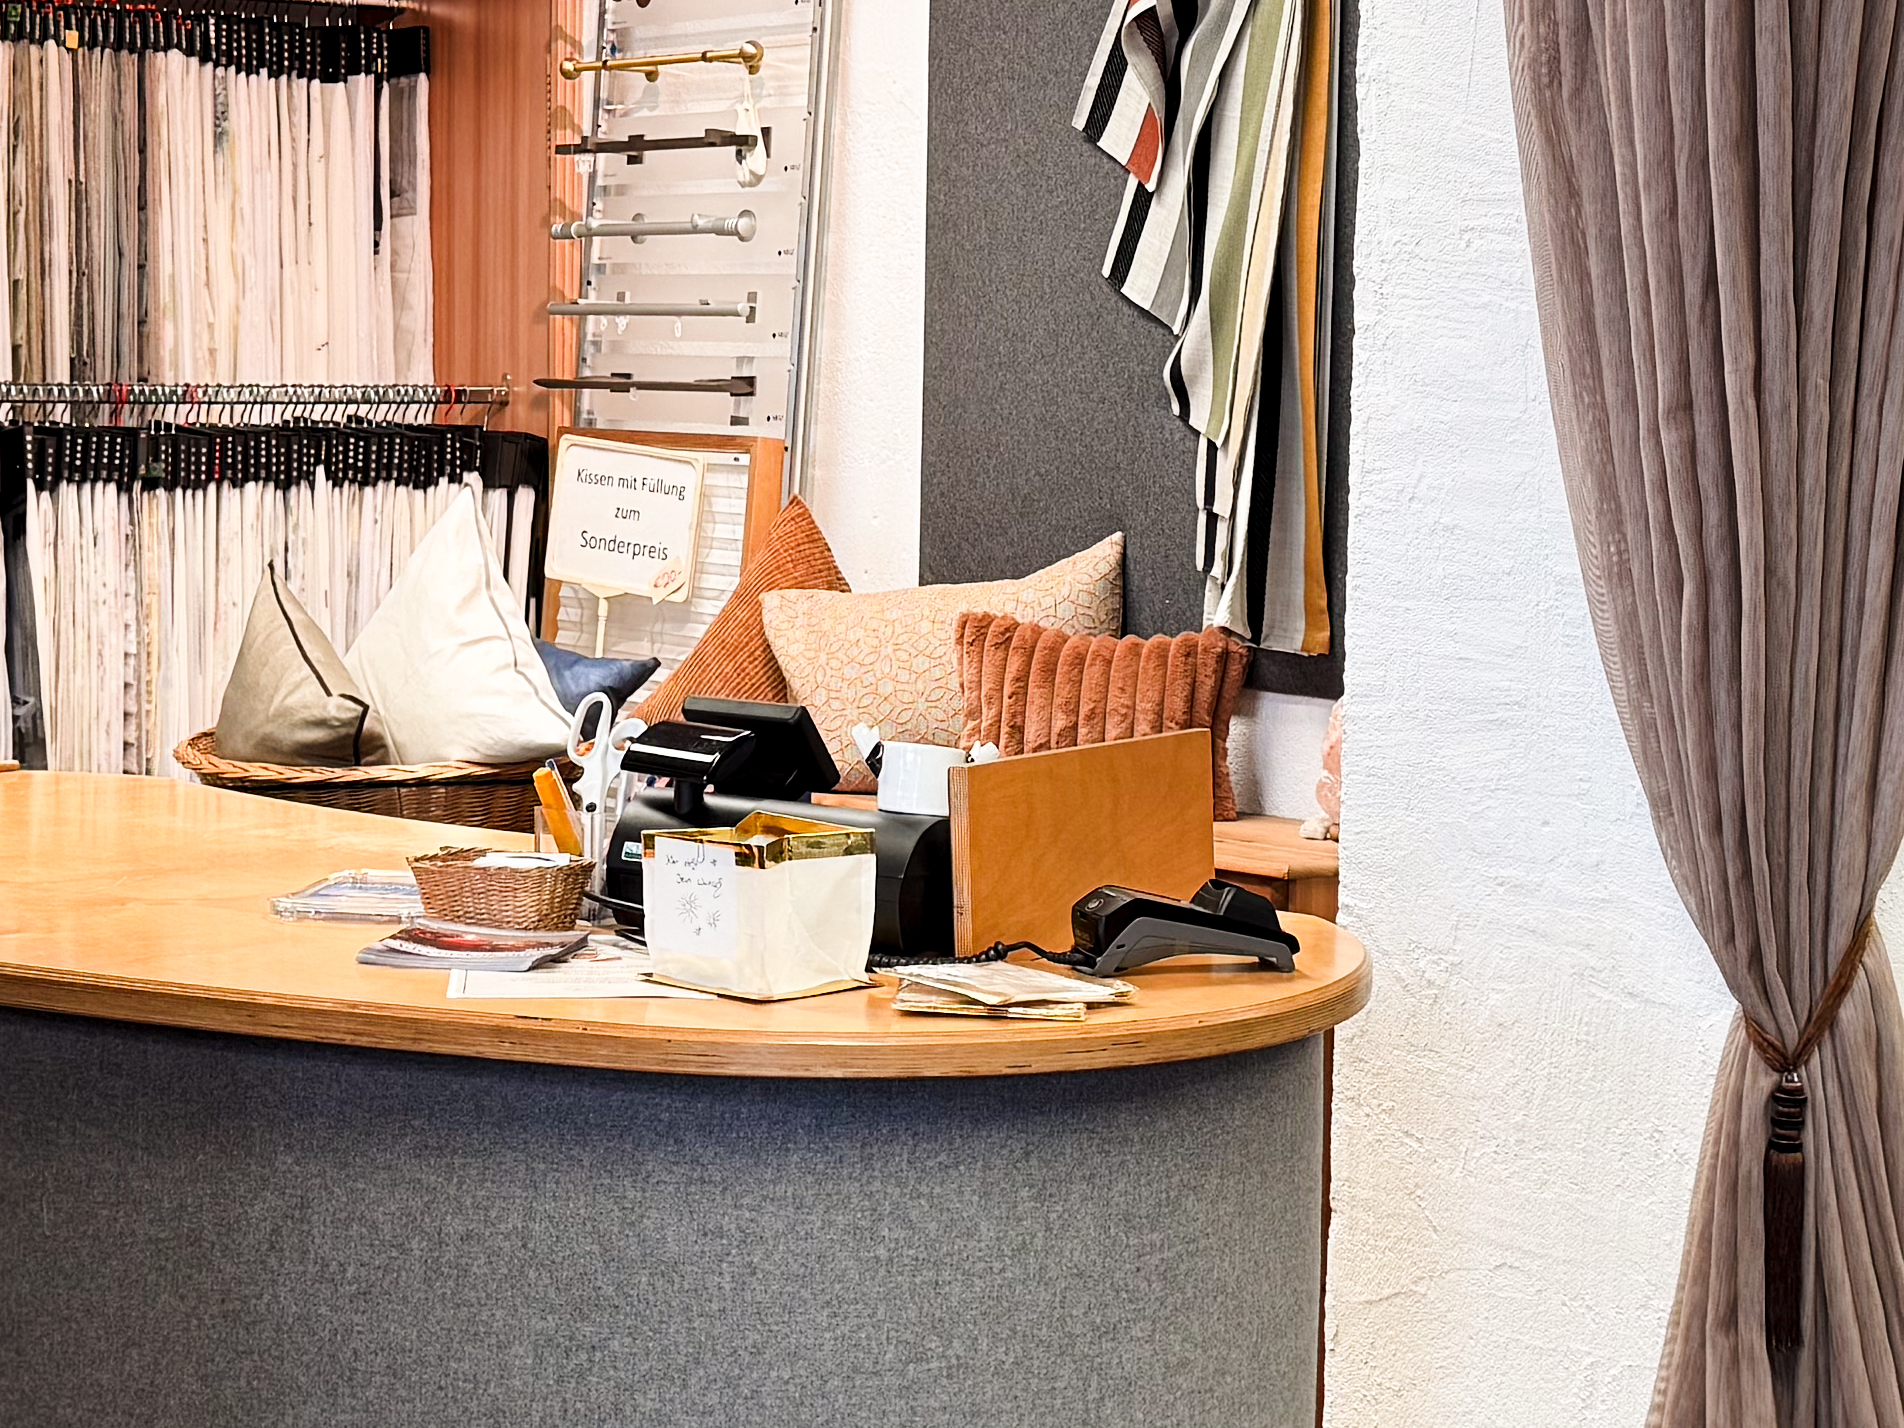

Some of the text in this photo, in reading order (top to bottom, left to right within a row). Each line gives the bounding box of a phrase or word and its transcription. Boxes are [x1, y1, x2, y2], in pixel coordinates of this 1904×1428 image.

[576, 468, 686, 501] Kissen mit Füllung
[614, 507, 641, 522] zum
[579, 530, 669, 561] Sonderpreis
